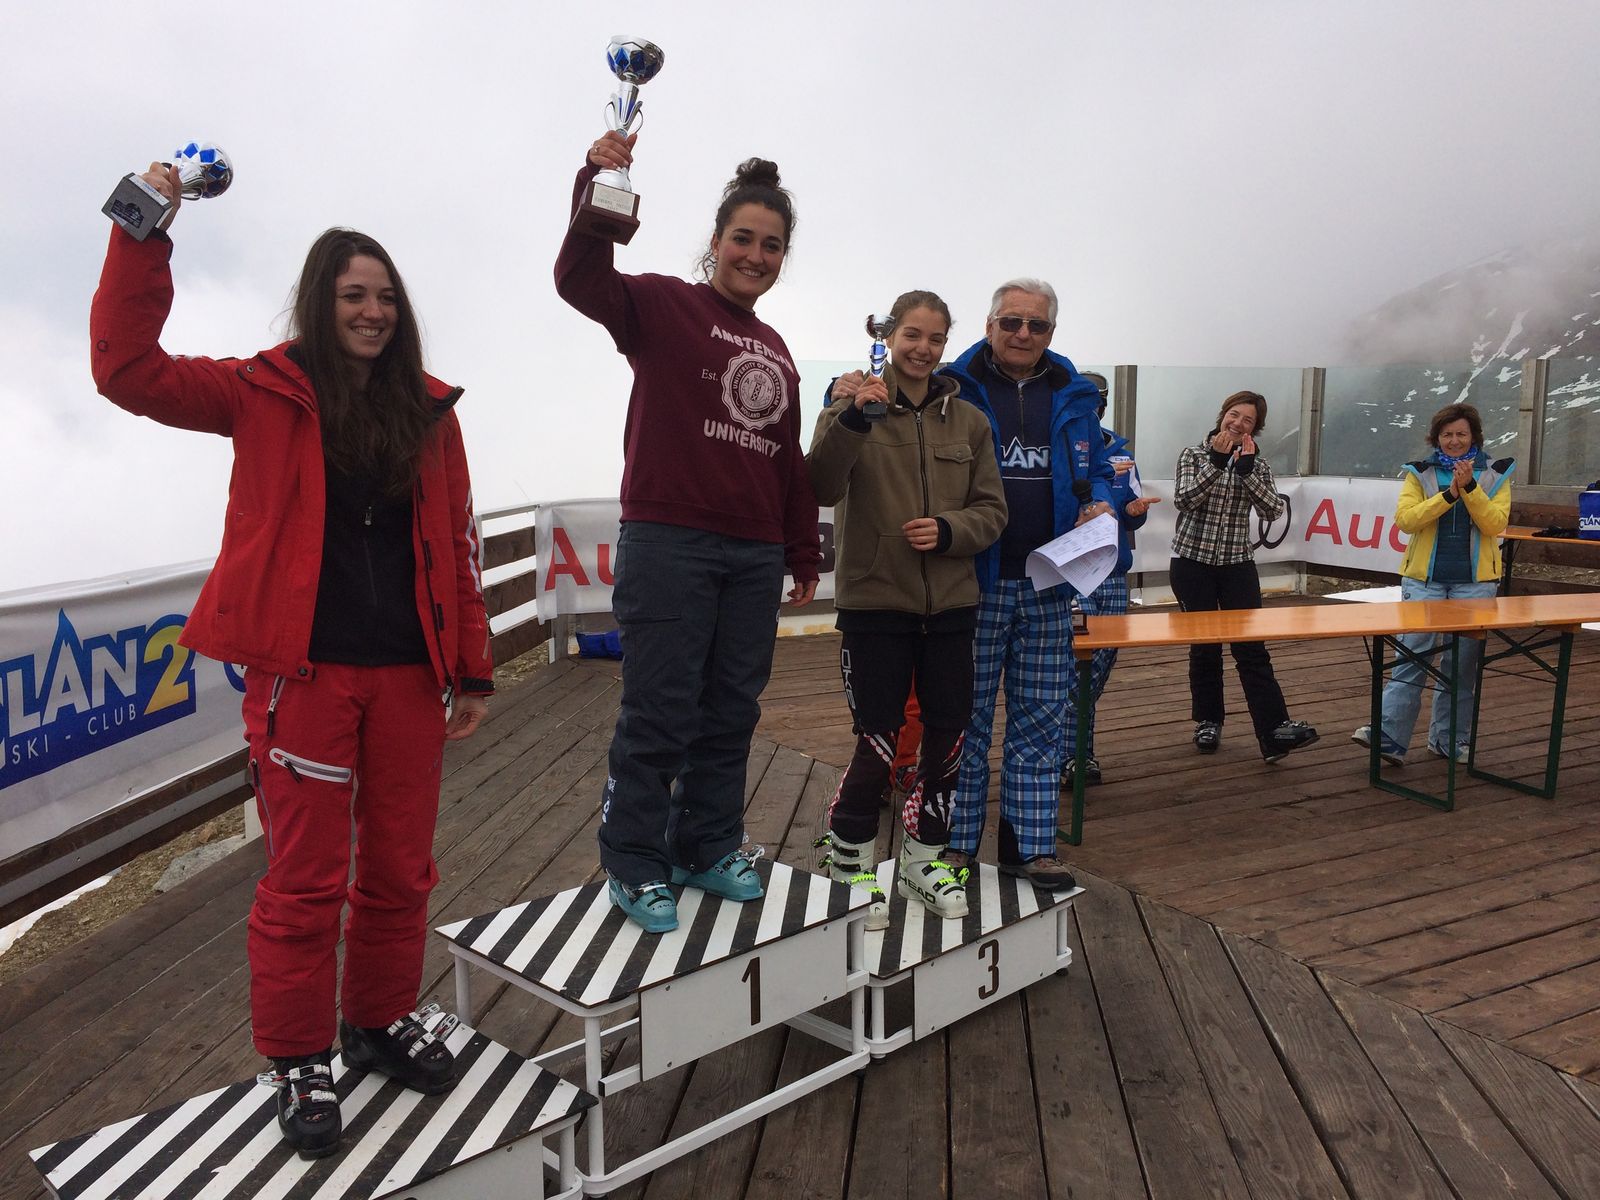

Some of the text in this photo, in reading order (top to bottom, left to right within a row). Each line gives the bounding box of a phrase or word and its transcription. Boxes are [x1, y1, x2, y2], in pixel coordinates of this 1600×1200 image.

[701, 368, 718, 381] Est.
[703, 418, 781, 458] UNIVERSITY
[12, 734, 49, 765] SKI
[87, 703, 136, 735] CLUB
[900, 873, 936, 904] HEAD
[741, 956, 761, 1026] 1
[977, 939, 1000, 1000] 3
